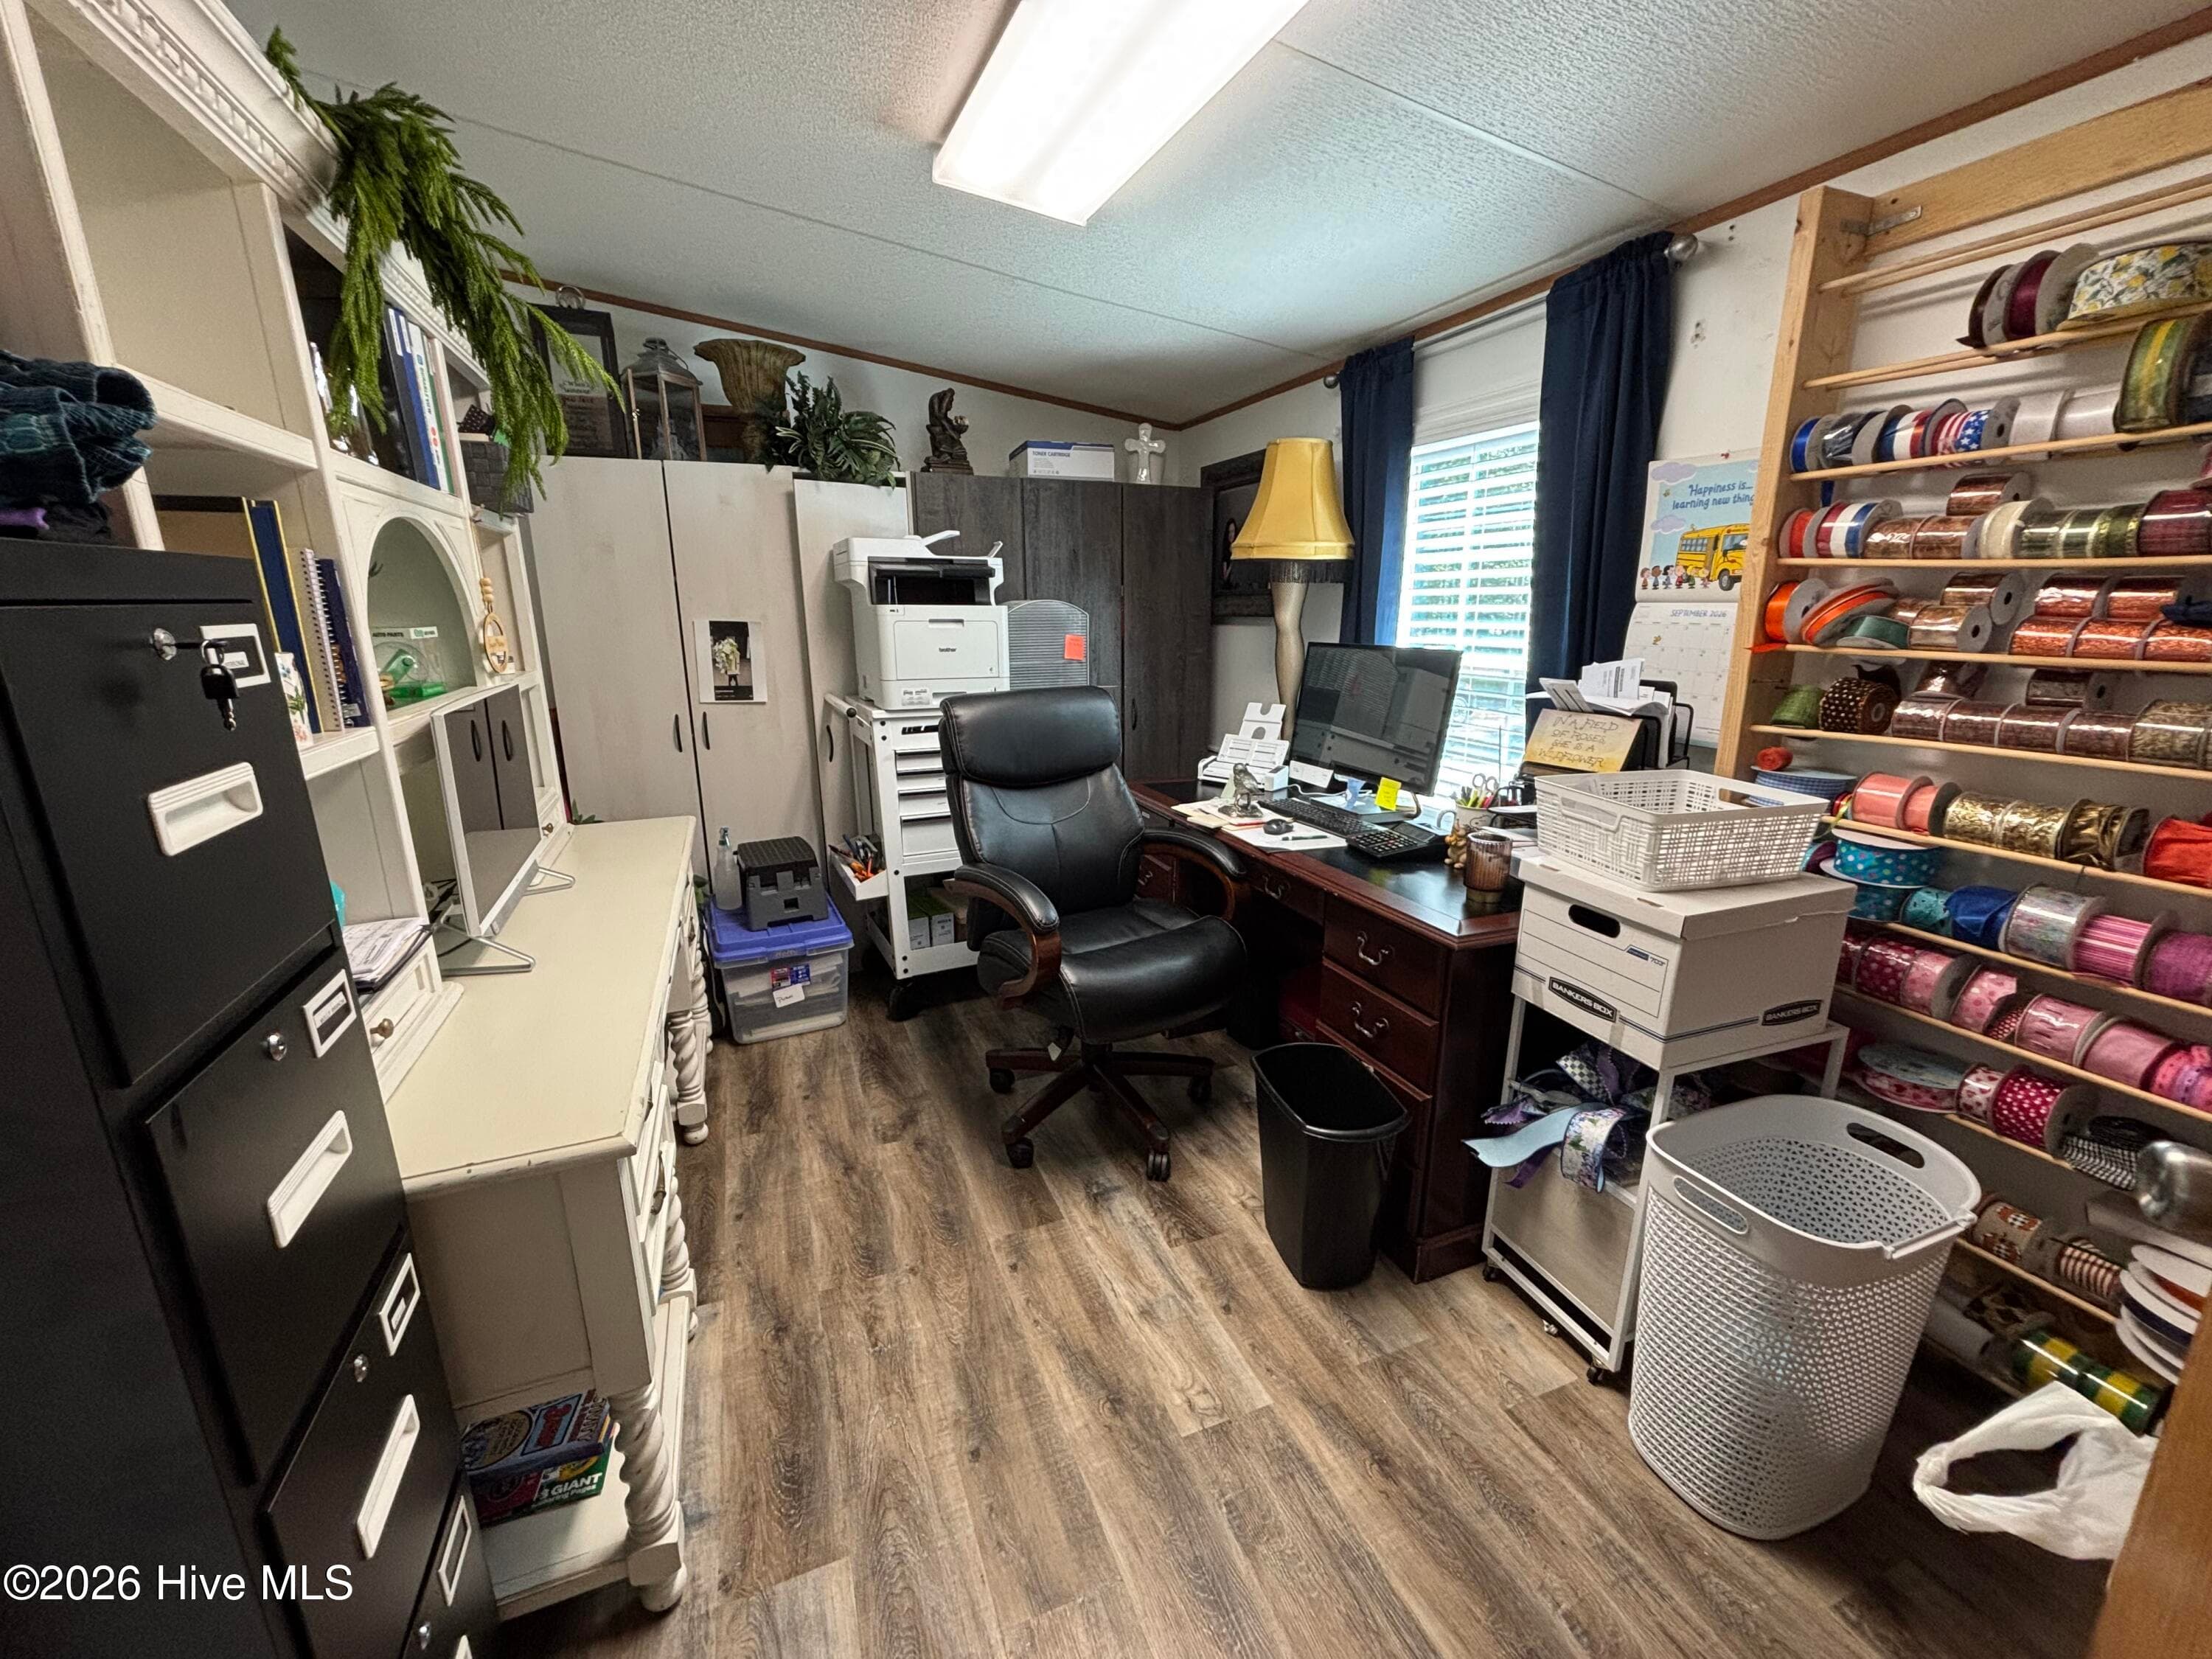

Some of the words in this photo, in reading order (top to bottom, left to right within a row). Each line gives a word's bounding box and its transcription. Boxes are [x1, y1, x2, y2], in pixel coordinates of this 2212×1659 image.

[1688, 482, 1736, 498] Happiness
[1672, 498, 1710, 510] learning
[1712, 498, 1731, 507] new
[1670, 609, 1708, 618] SEPTEMBER
[1709, 610, 1728, 618] 2026
[1578, 717, 1619, 733] FIELD
[1551, 729, 1569, 737] OF
[1551, 739, 1571, 748] SHE
[1552, 982, 1593, 1006] BANKERS
[1593, 1003, 1613, 1017] BOX
[1766, 1008, 1801, 1020] BANKERS
[1801, 1005, 1818, 1014] BOX
[552, 1472, 602, 1496] GIANT
